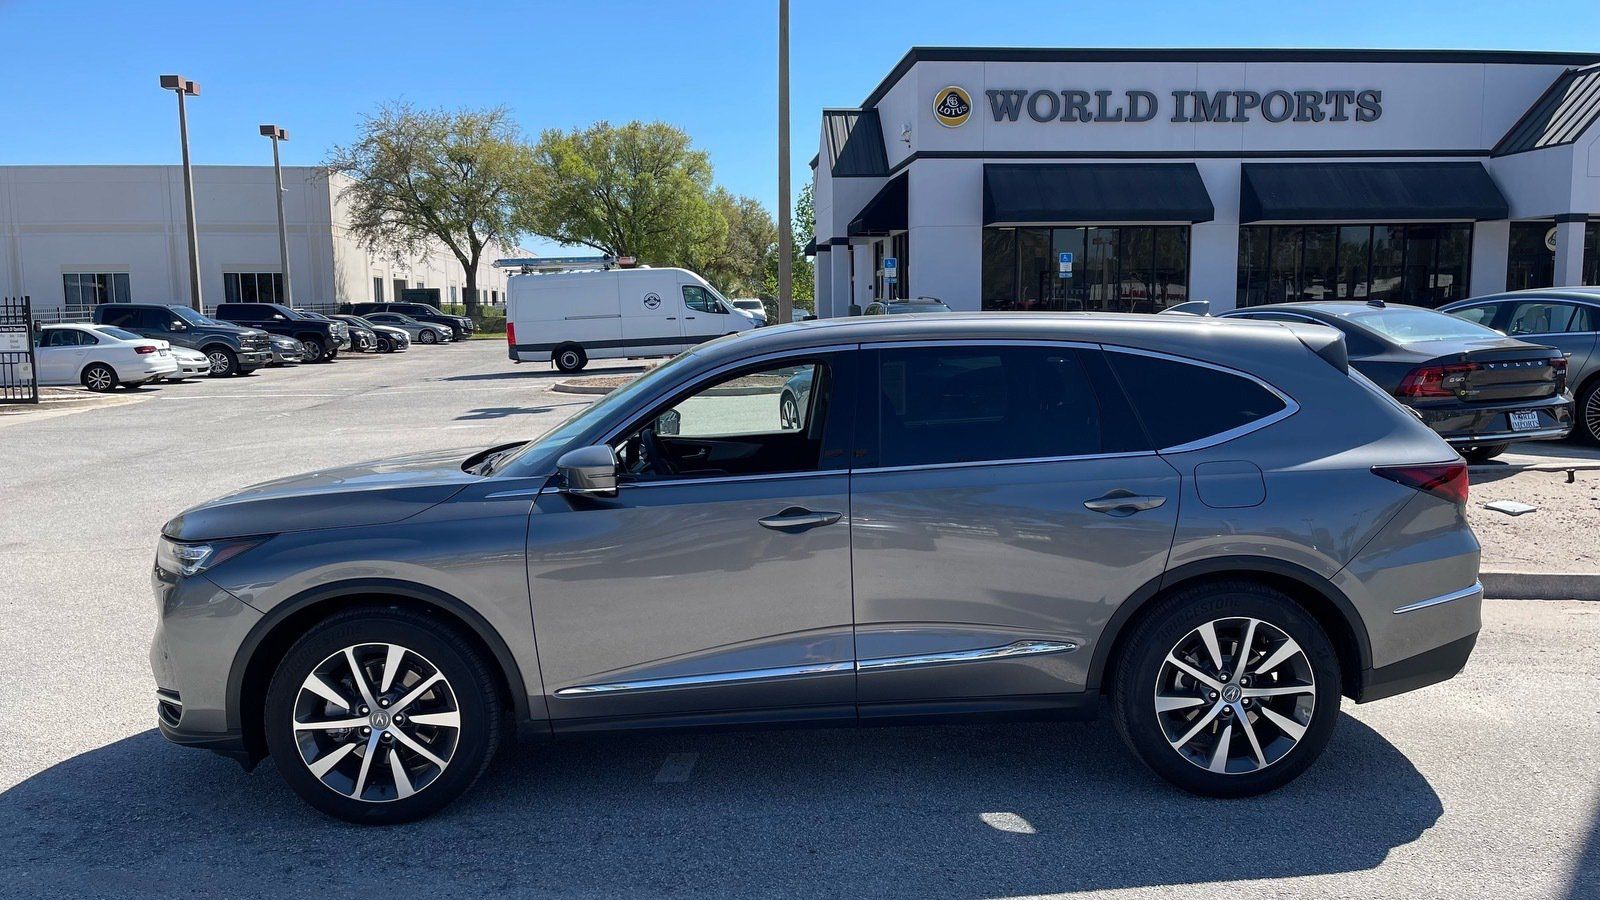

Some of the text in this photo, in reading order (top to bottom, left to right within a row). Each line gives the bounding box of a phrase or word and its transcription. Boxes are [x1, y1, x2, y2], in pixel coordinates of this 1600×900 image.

[939, 105, 968, 116] LOTUS
[985, 89, 1383, 123] WORLD IMPORTS
[1489, 361, 1543, 369] VOLVO
[1511, 413, 1536, 421] WORLD
